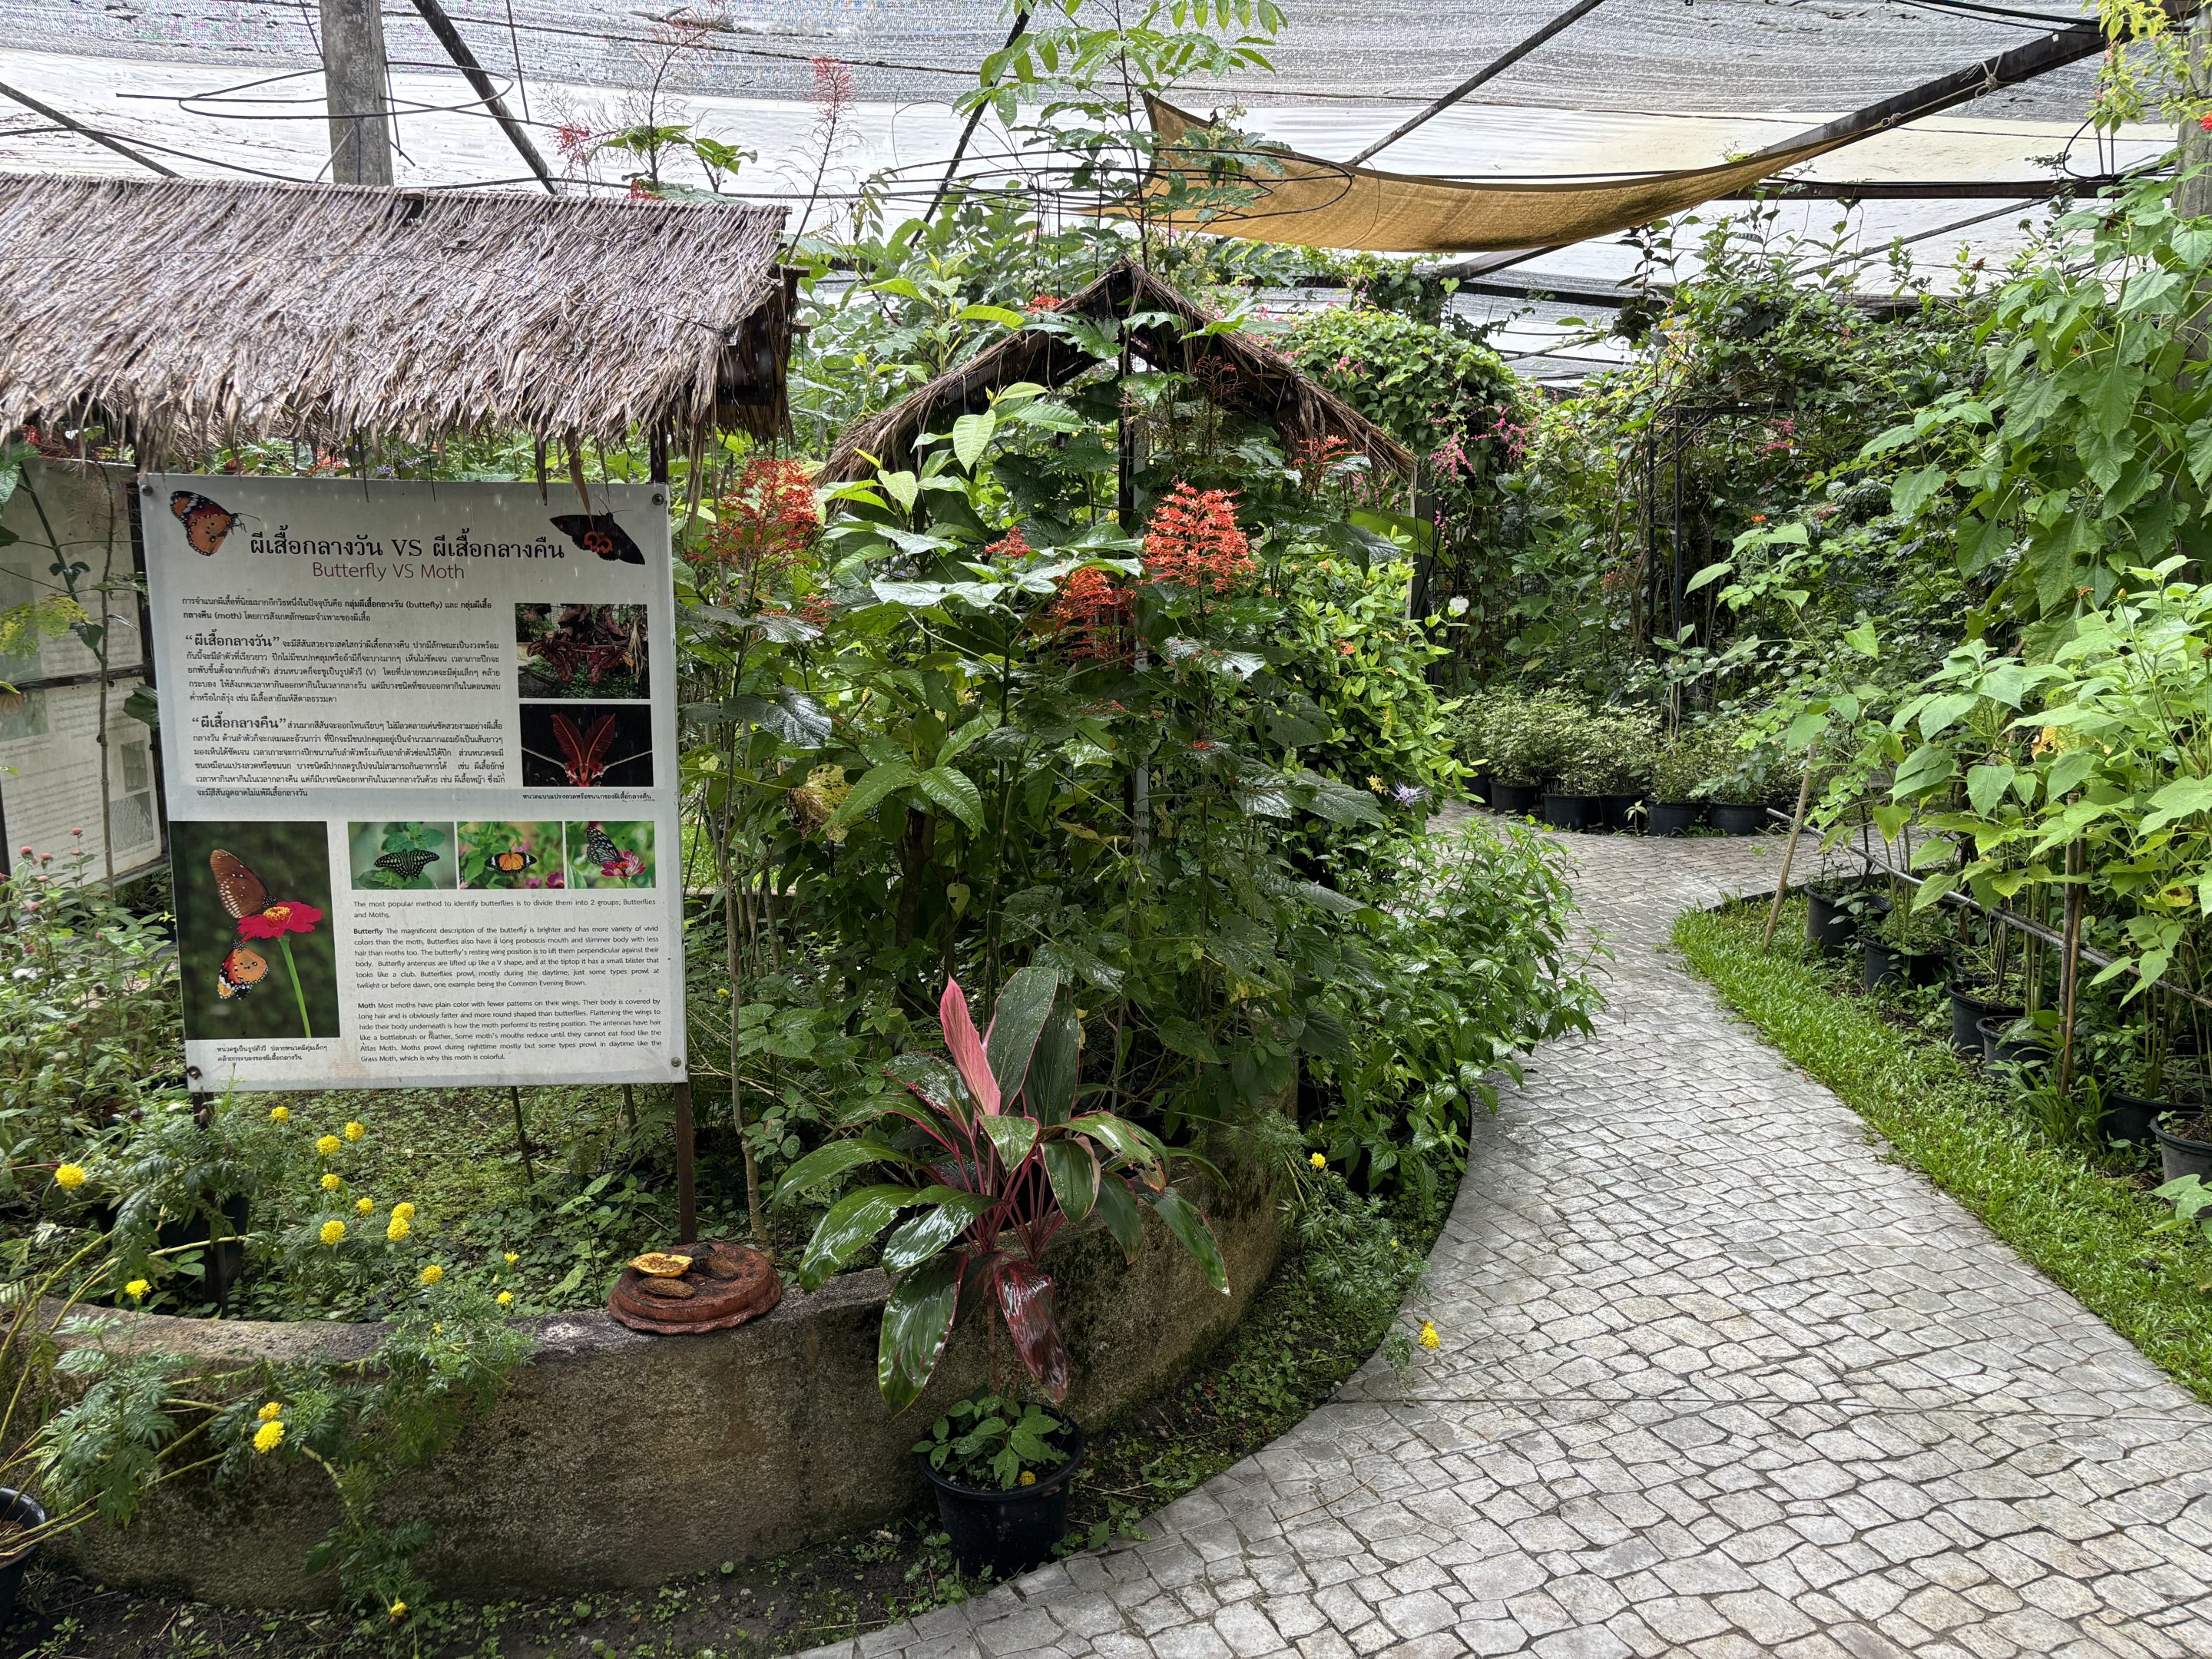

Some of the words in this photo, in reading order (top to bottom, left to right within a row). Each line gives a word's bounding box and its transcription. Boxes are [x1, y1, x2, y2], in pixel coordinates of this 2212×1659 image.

[251, 525, 384, 558] ผีเสื้อกลางวัน
[392, 538, 422, 558] VS
[433, 528, 565, 559] ผีเสื้อกลางคืน
[313, 561, 387, 582] Butterfly
[392, 564, 415, 579] VS
[421, 564, 464, 579] Moth
[345, 597, 404, 610] กลุ่มผีเสื้อกลางวัน
[406, 601, 442, 610] (buttefly)
[460, 598, 492, 611] กลุ่มผีเสื้อ
[183, 610, 212, 619] กลางคืน
[214, 611, 242, 620] (moth)
[366, 668, 376, 677] (V)
[482, 667, 500, 677] คล้าย
[236, 693, 249, 702] เช่น
[440, 775, 452, 783] เช่น
[388, 900, 414, 909] popular
[454, 900, 478, 909] identify
[401, 927, 438, 935] magnificent
[439, 927, 475, 935] description
[500, 926, 528, 935] butterfly
[537, 926, 561, 935] brighter
[515, 937, 546, 945] proboscis
[456, 970, 475, 979] prowl
[504, 969, 524, 978] during
[527, 969, 538, 979] the
[356, 982, 380, 990] twilight
[448, 981, 475, 989] example
